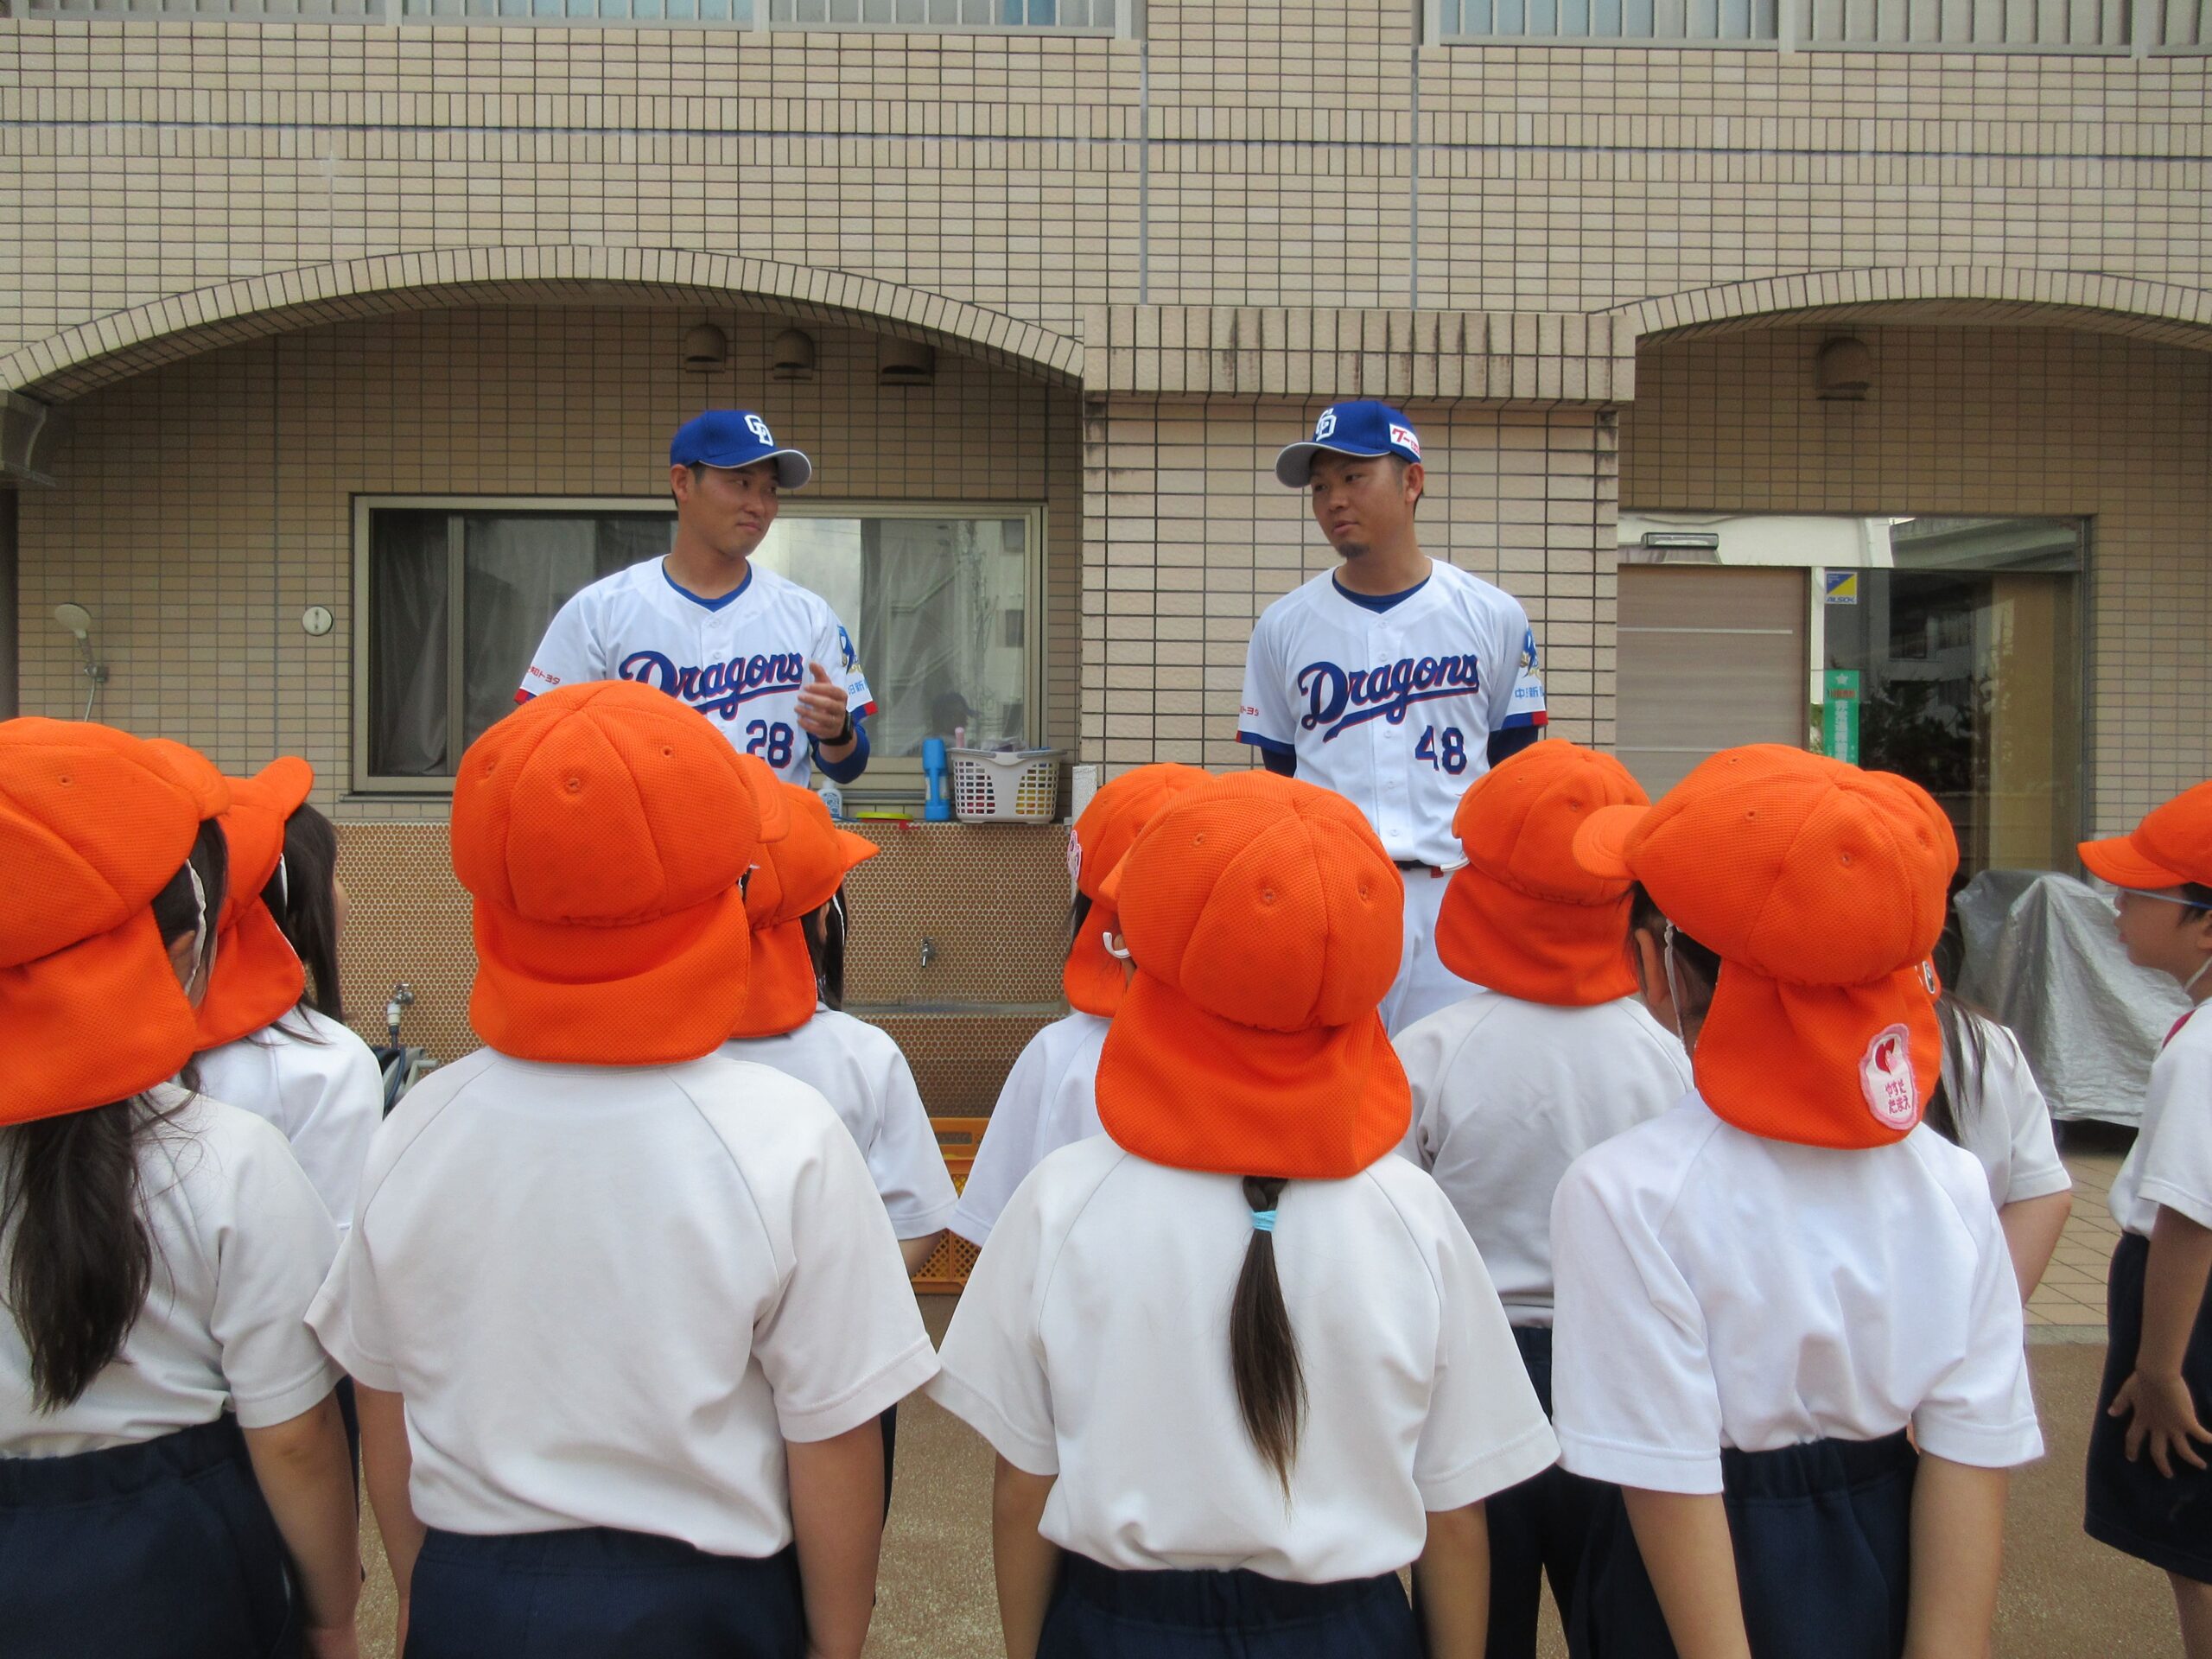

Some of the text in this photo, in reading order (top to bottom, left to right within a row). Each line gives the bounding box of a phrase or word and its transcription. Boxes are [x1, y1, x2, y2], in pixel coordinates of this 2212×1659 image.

[619, 650, 804, 721] Dragons
[1297, 654, 1479, 731] Dragons
[746, 719, 794, 769] 28
[1414, 725, 1468, 774] 48
